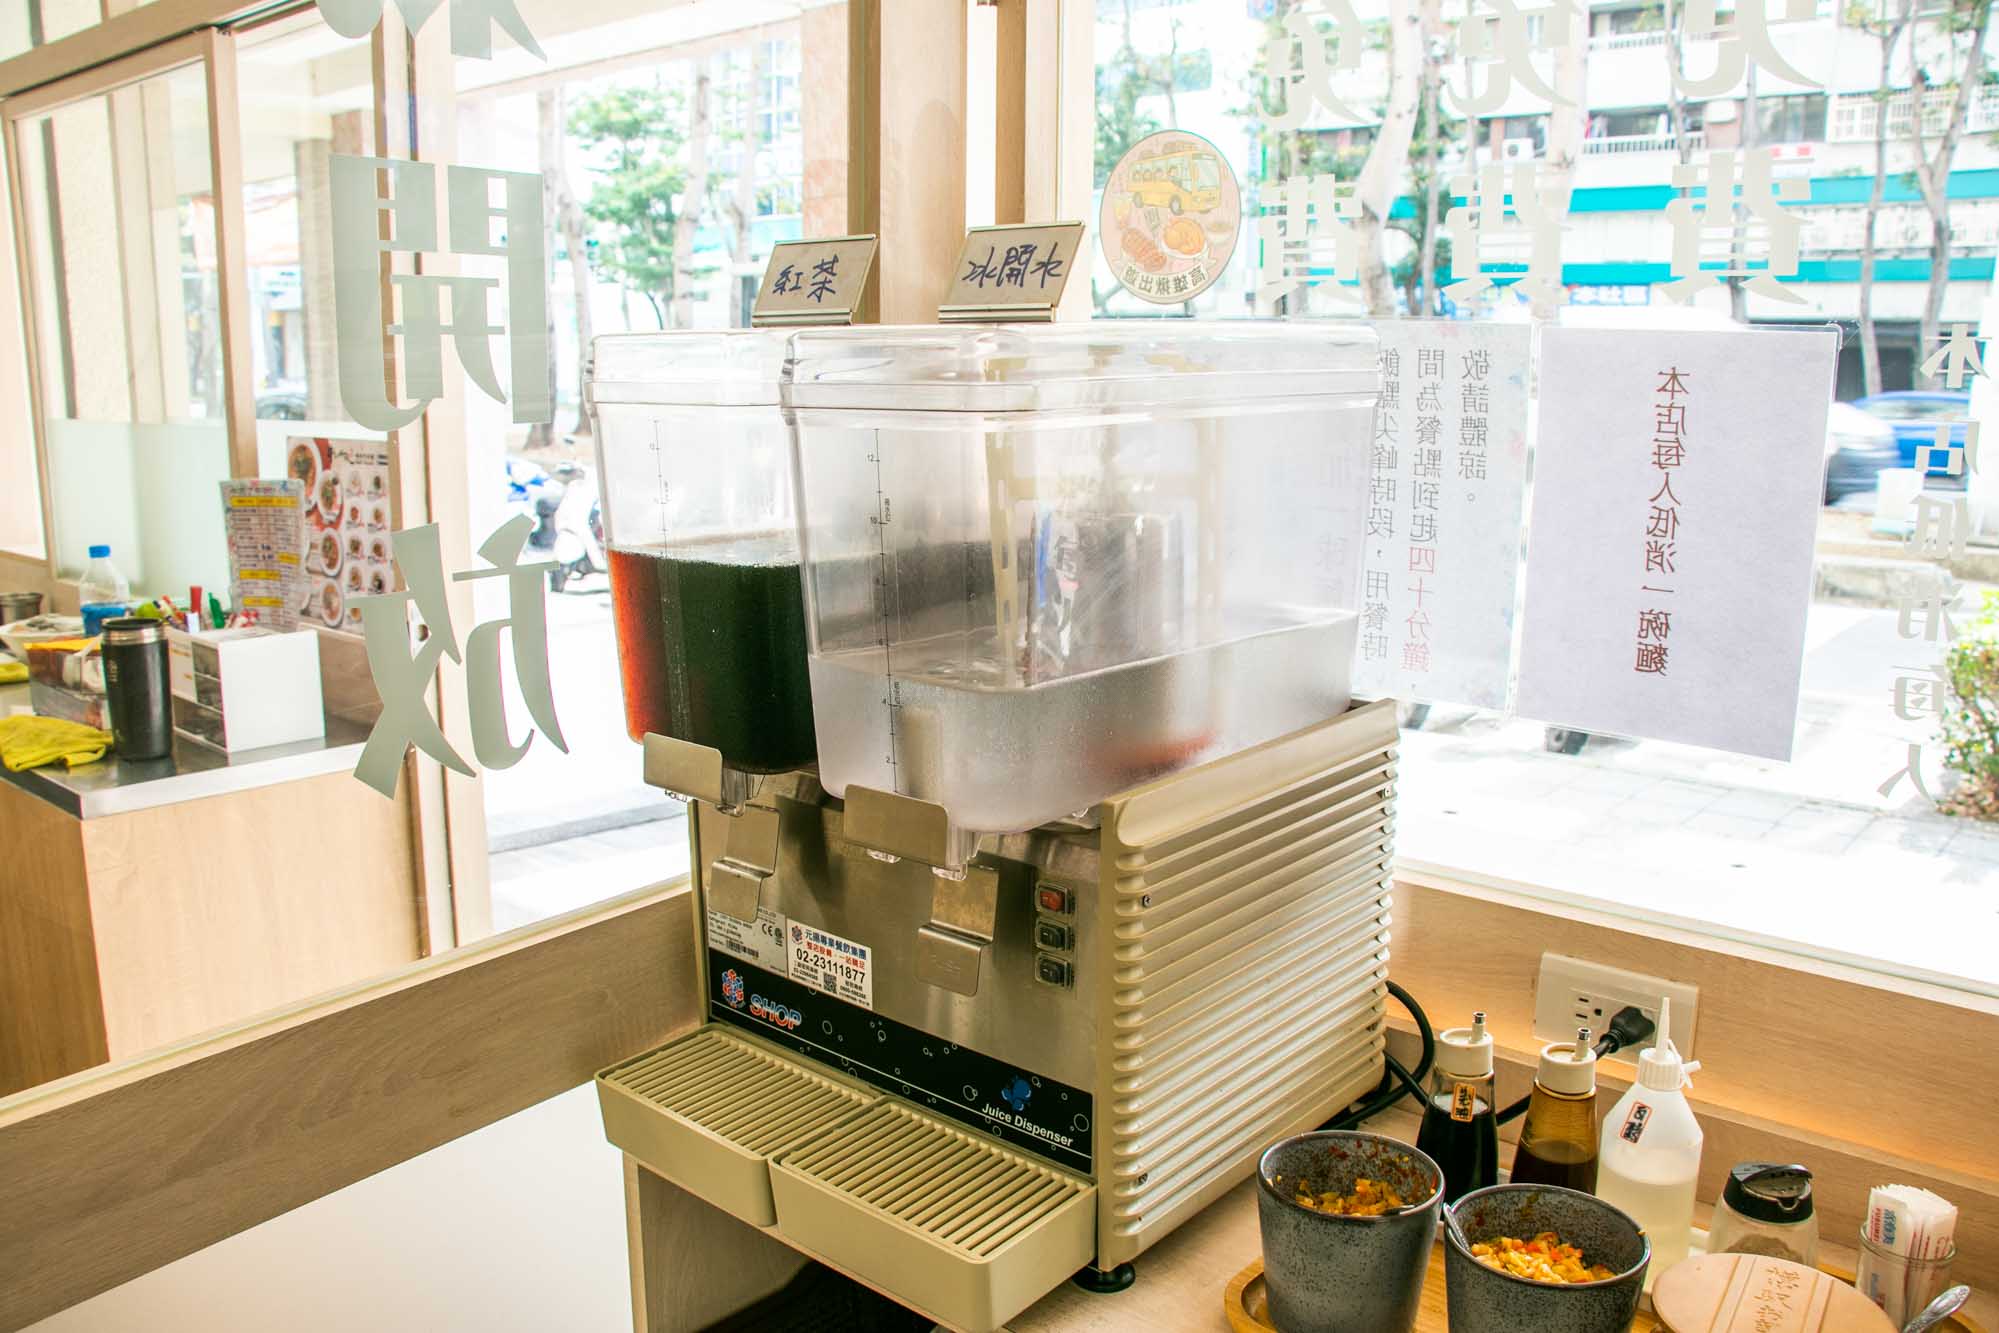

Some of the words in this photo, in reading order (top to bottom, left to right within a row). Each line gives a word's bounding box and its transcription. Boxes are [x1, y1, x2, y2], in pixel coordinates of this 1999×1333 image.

[772, 254, 840, 303] 紅茶
[960, 241, 1064, 292] 冰開水
[797, 948, 866, 984] 02-23111877
[750, 993, 803, 1031] SHOP
[982, 1102, 1012, 1124] Juice
[1013, 1113, 1074, 1148] Dispenser
